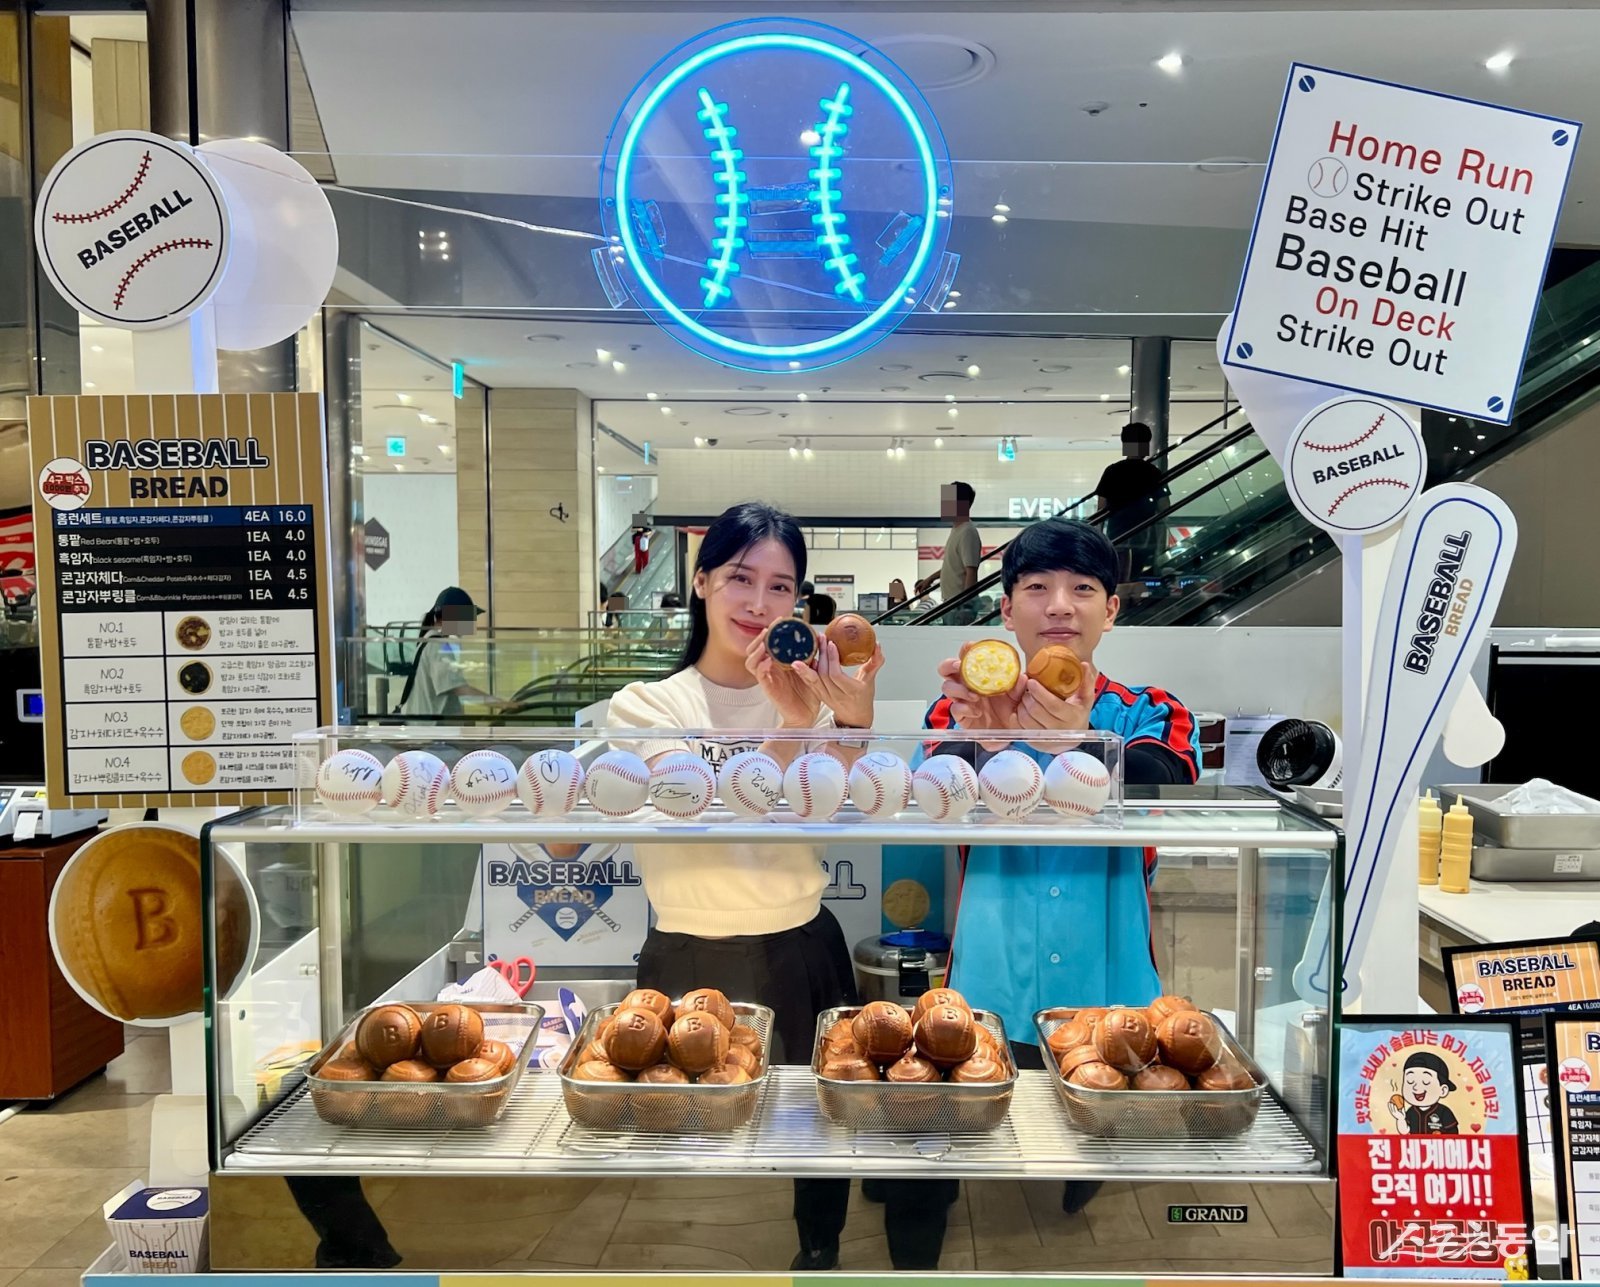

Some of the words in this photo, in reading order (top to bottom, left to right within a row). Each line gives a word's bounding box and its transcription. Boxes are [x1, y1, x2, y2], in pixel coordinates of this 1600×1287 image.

[1327, 119, 1443, 176] Home
[1456, 148, 1534, 195] Run
[1353, 171, 1451, 218] Strike
[1465, 196, 1526, 235] Out
[76, 190, 193, 270] BASEBALL
[1285, 194, 1368, 238] Base
[1379, 214, 1430, 251] Hit
[1275, 231, 1468, 307] Baseball
[1315, 286, 1360, 321] On
[1371, 297, 1457, 341] Deck
[1276, 313, 1375, 359] Strike
[1388, 337, 1449, 376] Out
[85, 438, 270, 471] BASEBALL
[1311, 444, 1406, 485] BASEBALL
[129, 476, 229, 500] BREAD
[56, 512, 102, 526] 홈런세트
[244, 510, 270, 522] 4EA
[279, 510, 306, 522] 16.0
[58, 534, 81, 547] 통팥
[246, 531, 271, 542] 1EA
[285, 529, 306, 541] 4.0
[59, 552, 93, 565] 흑임자
[247, 550, 272, 562] 1EA
[286, 549, 307, 561] 4.0
[61, 571, 123, 585] 콘감자체다
[248, 569, 272, 581] 1EA
[286, 568, 308, 580] 4.5
[62, 589, 137, 604] 콘감자뿌링클
[249, 589, 273, 600] 1EA
[287, 588, 308, 600] 4.5
[1403, 530, 1473, 675] BASEBALL
[1444, 578, 1474, 638] BREAD
[99, 621, 124, 634] NO.1
[100, 667, 125, 680] NO.2
[104, 711, 129, 723] NO.3
[105, 756, 131, 769] NO.4
[488, 860, 642, 887] BASEBALL
[533, 889, 596, 904] BREAD
[127, 887, 182, 950] B
[1477, 952, 1576, 978] BASEBALL
[1503, 975, 1556, 992] BREAD
[1568, 1003, 1583, 1011] 4EA
[1389, 1029, 1439, 1052] 솔솔나는
[1360, 1043, 1390, 1081] 냄새가
[1467, 1056, 1492, 1085] 지금
[1355, 1083, 1373, 1125] 맛있는
[1481, 1086, 1500, 1120] 이곳!
[1570, 1120, 1592, 1130] 흑임자
[1368, 1139, 1392, 1170] 전
[1398, 1139, 1492, 1170] 세계에서
[1371, 1174, 1417, 1206] 오직
[1424, 1174, 1493, 1206] 여기!!
[1185, 1208, 1244, 1221] GRAND
[129, 1250, 189, 1259] BASEBALL
[142, 1261, 178, 1269] BREAD
